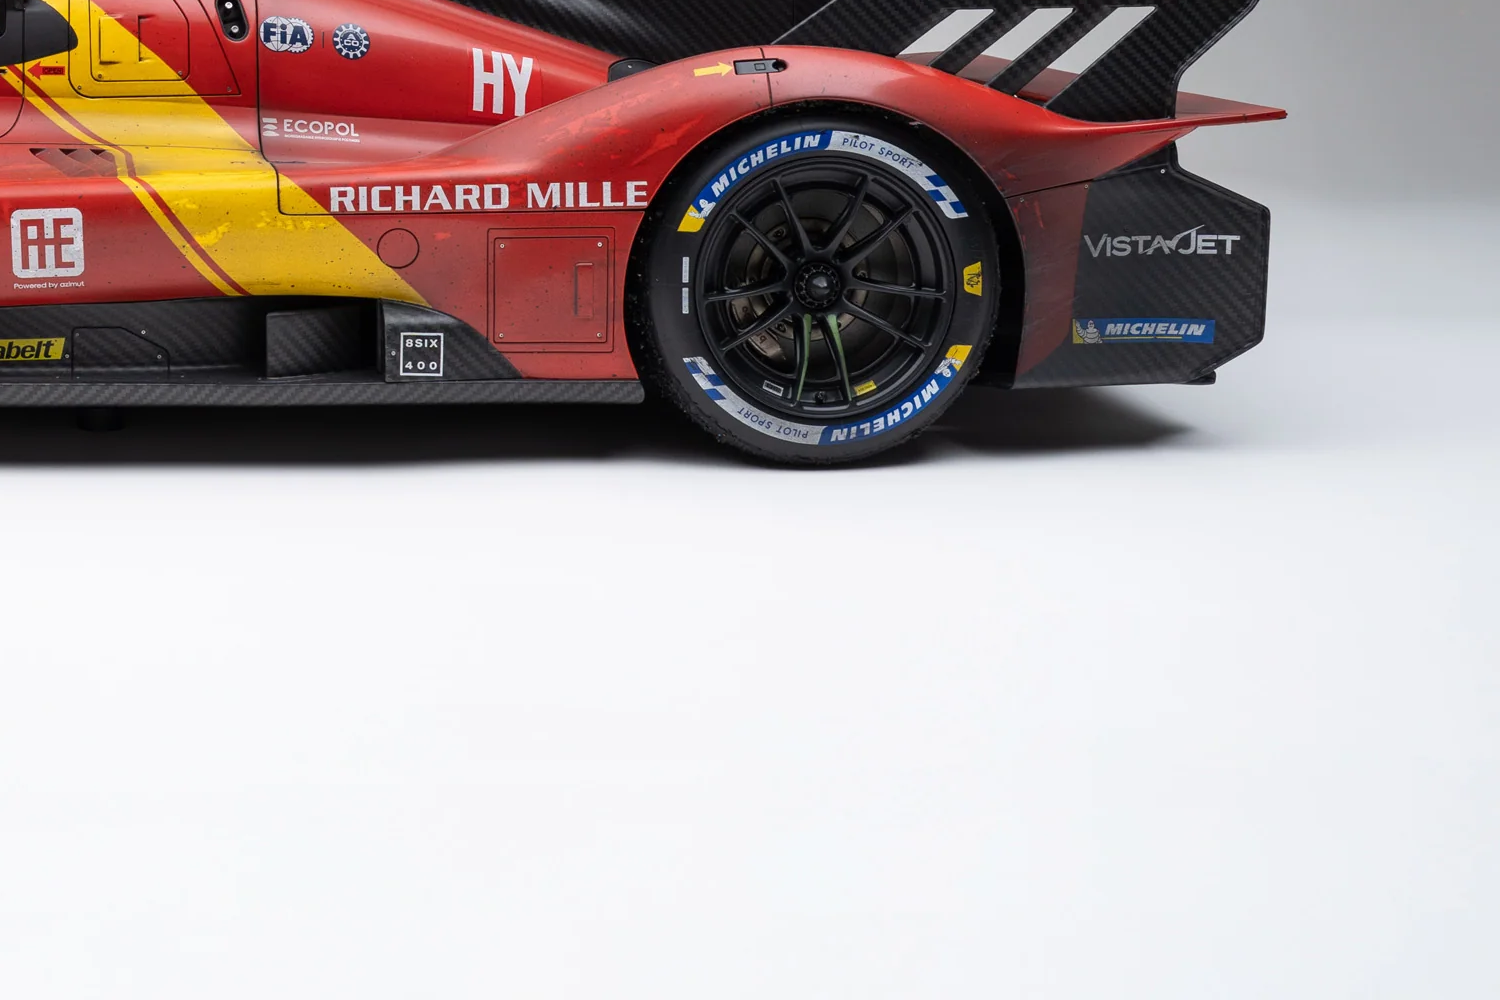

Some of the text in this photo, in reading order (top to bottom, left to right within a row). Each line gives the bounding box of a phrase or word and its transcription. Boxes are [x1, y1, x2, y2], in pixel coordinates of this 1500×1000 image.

[472, 47, 534, 118] HY
[283, 119, 360, 137] ECOPOL
[710, 134, 821, 197] MICHELIN
[842, 137, 915, 170] PILOT SPORT
[329, 180, 649, 212] RICHARD MILLE
[13, 280, 85, 290] Powered by azimut
[405, 338, 438, 348] 8SIX
[1104, 322, 1206, 336] MICHELIN
[404, 361, 438, 371] 400
[736, 406, 809, 439] PILOT SPORT
[830, 378, 940, 442] MICHELIN
